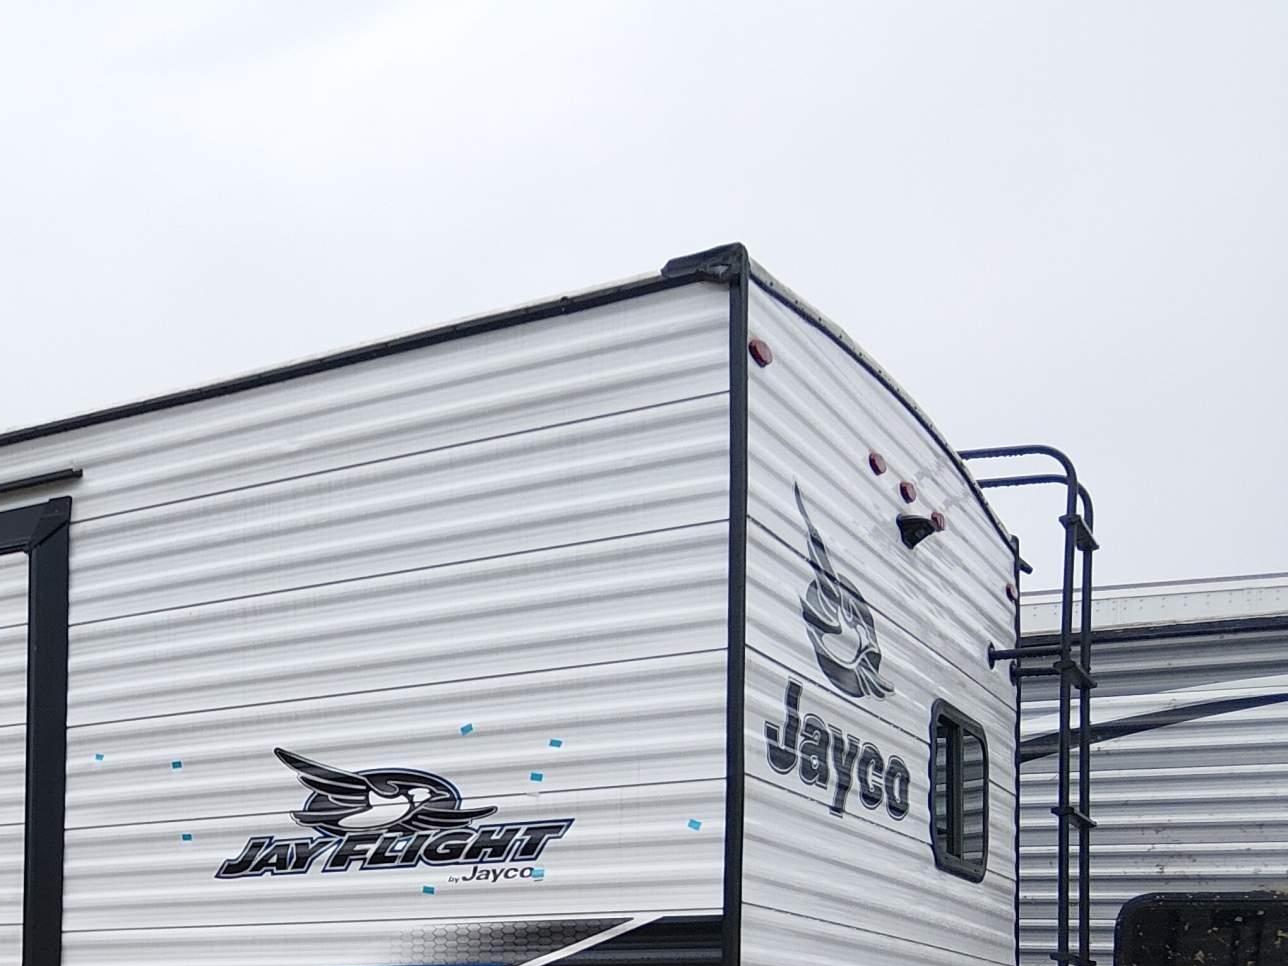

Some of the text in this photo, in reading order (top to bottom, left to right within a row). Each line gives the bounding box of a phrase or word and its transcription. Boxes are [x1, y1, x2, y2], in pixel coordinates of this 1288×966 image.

[764, 675, 911, 821] Jayco
[215, 818, 575, 878] JAY FLIGHT
[461, 865, 535, 883] Jayco
